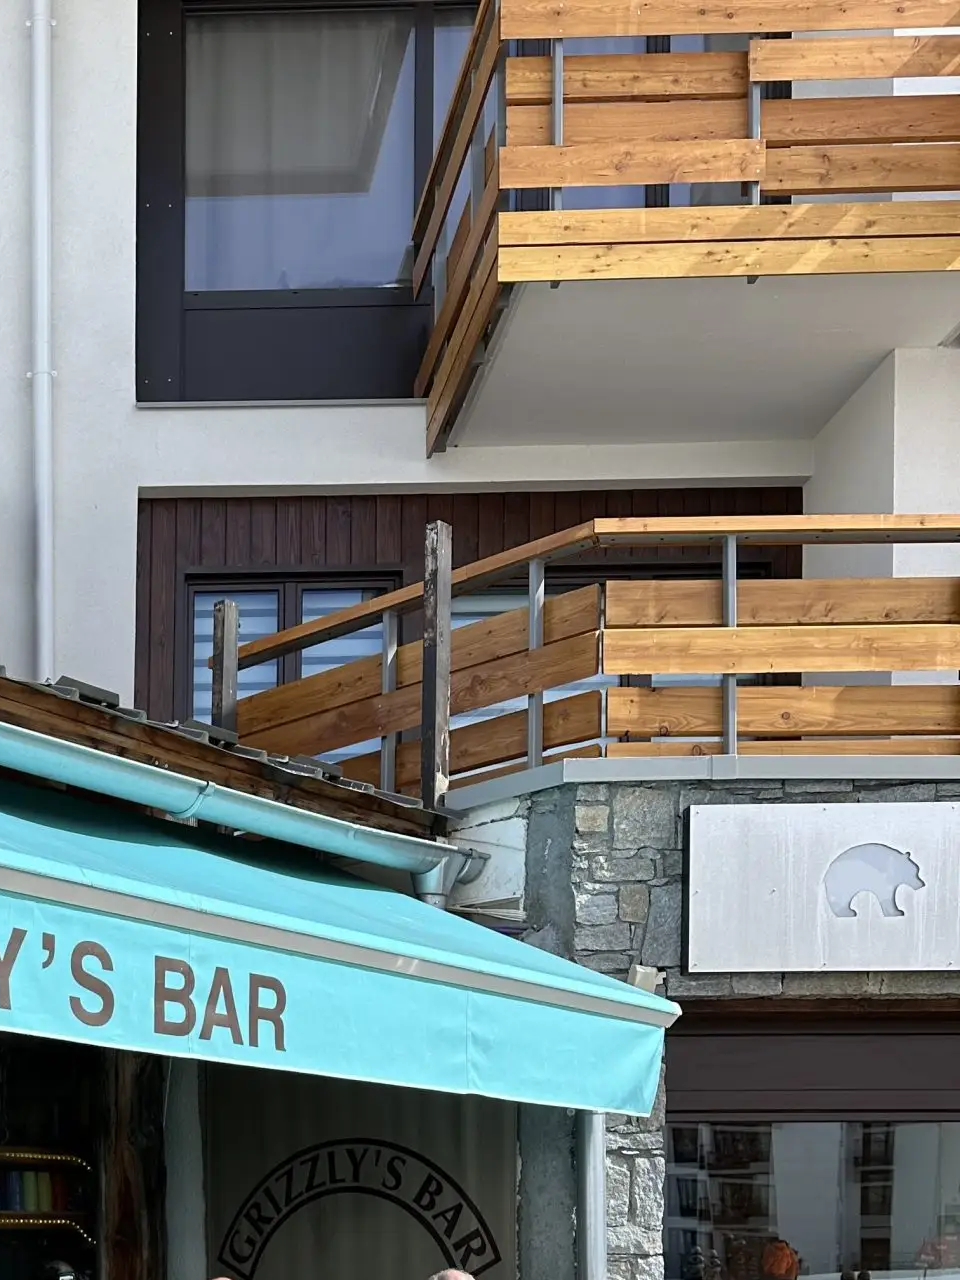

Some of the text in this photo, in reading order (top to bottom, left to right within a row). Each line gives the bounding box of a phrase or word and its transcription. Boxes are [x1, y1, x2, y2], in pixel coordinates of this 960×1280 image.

[154, 955, 287, 1052] BAR
[228, 1147, 488, 1270] GRIZZLY'S BAR
